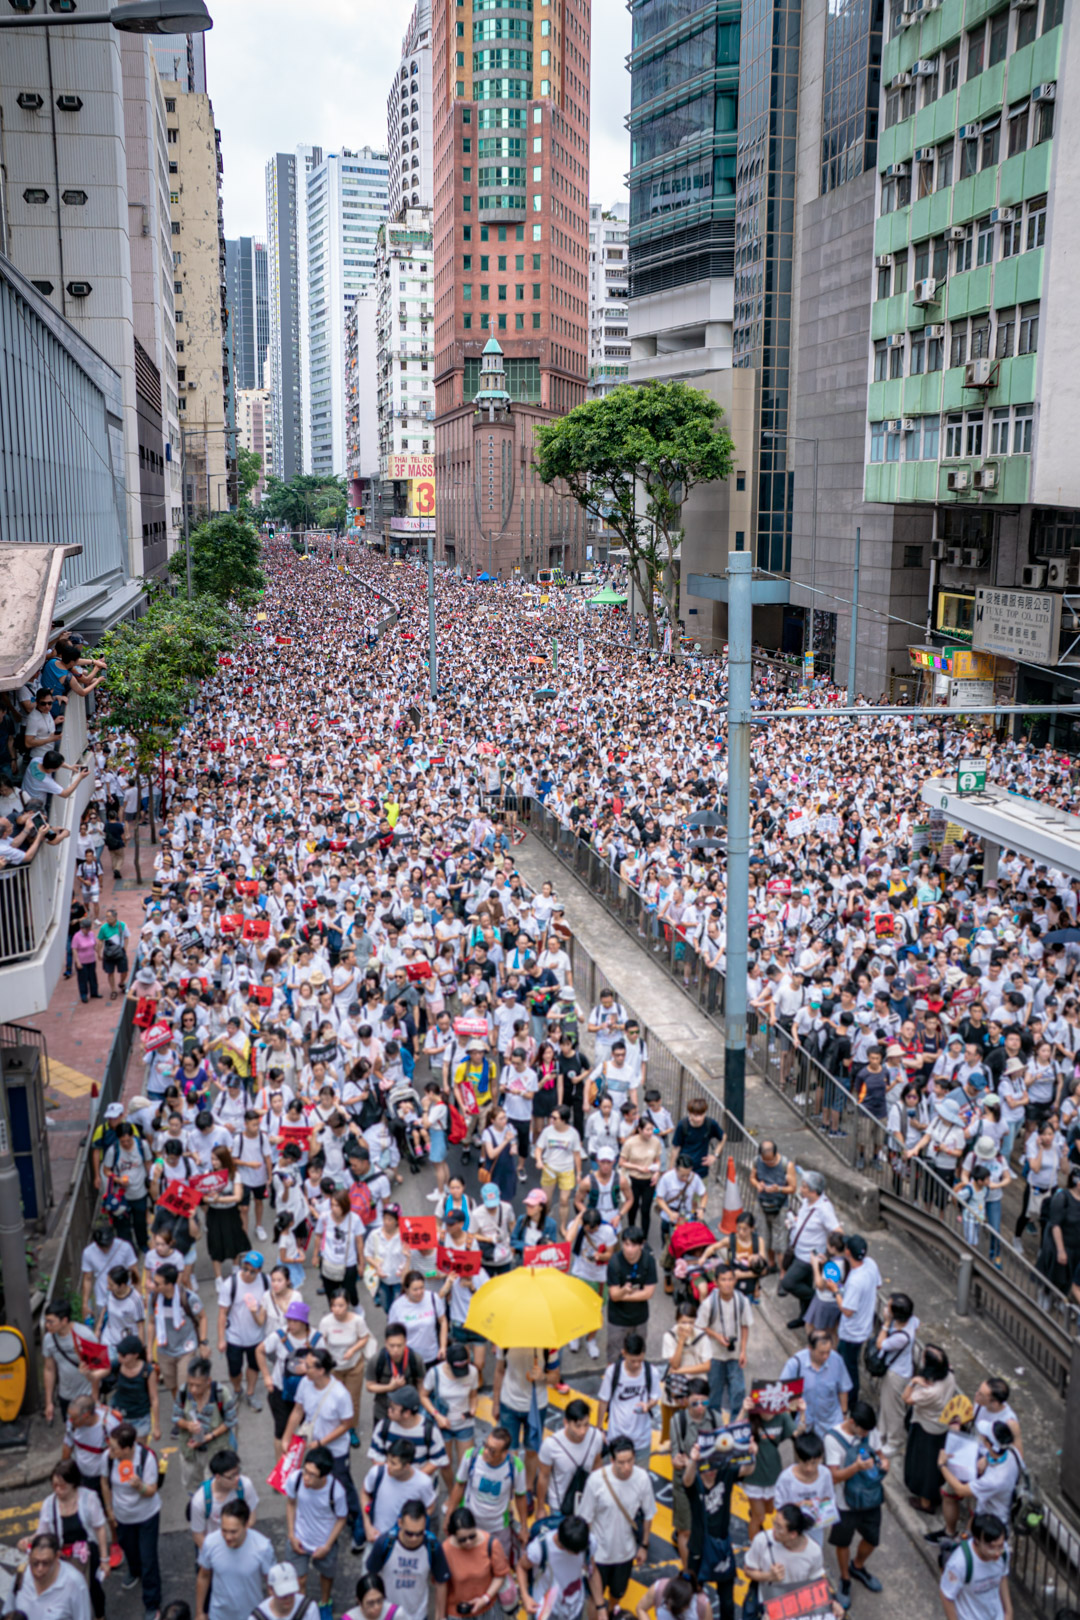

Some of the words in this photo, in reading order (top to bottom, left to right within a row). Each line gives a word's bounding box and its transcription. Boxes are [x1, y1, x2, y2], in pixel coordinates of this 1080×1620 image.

[395, 464, 405, 477] 3F
[416, 482, 435, 513] 3
[1006, 609, 1019, 619] TOP
